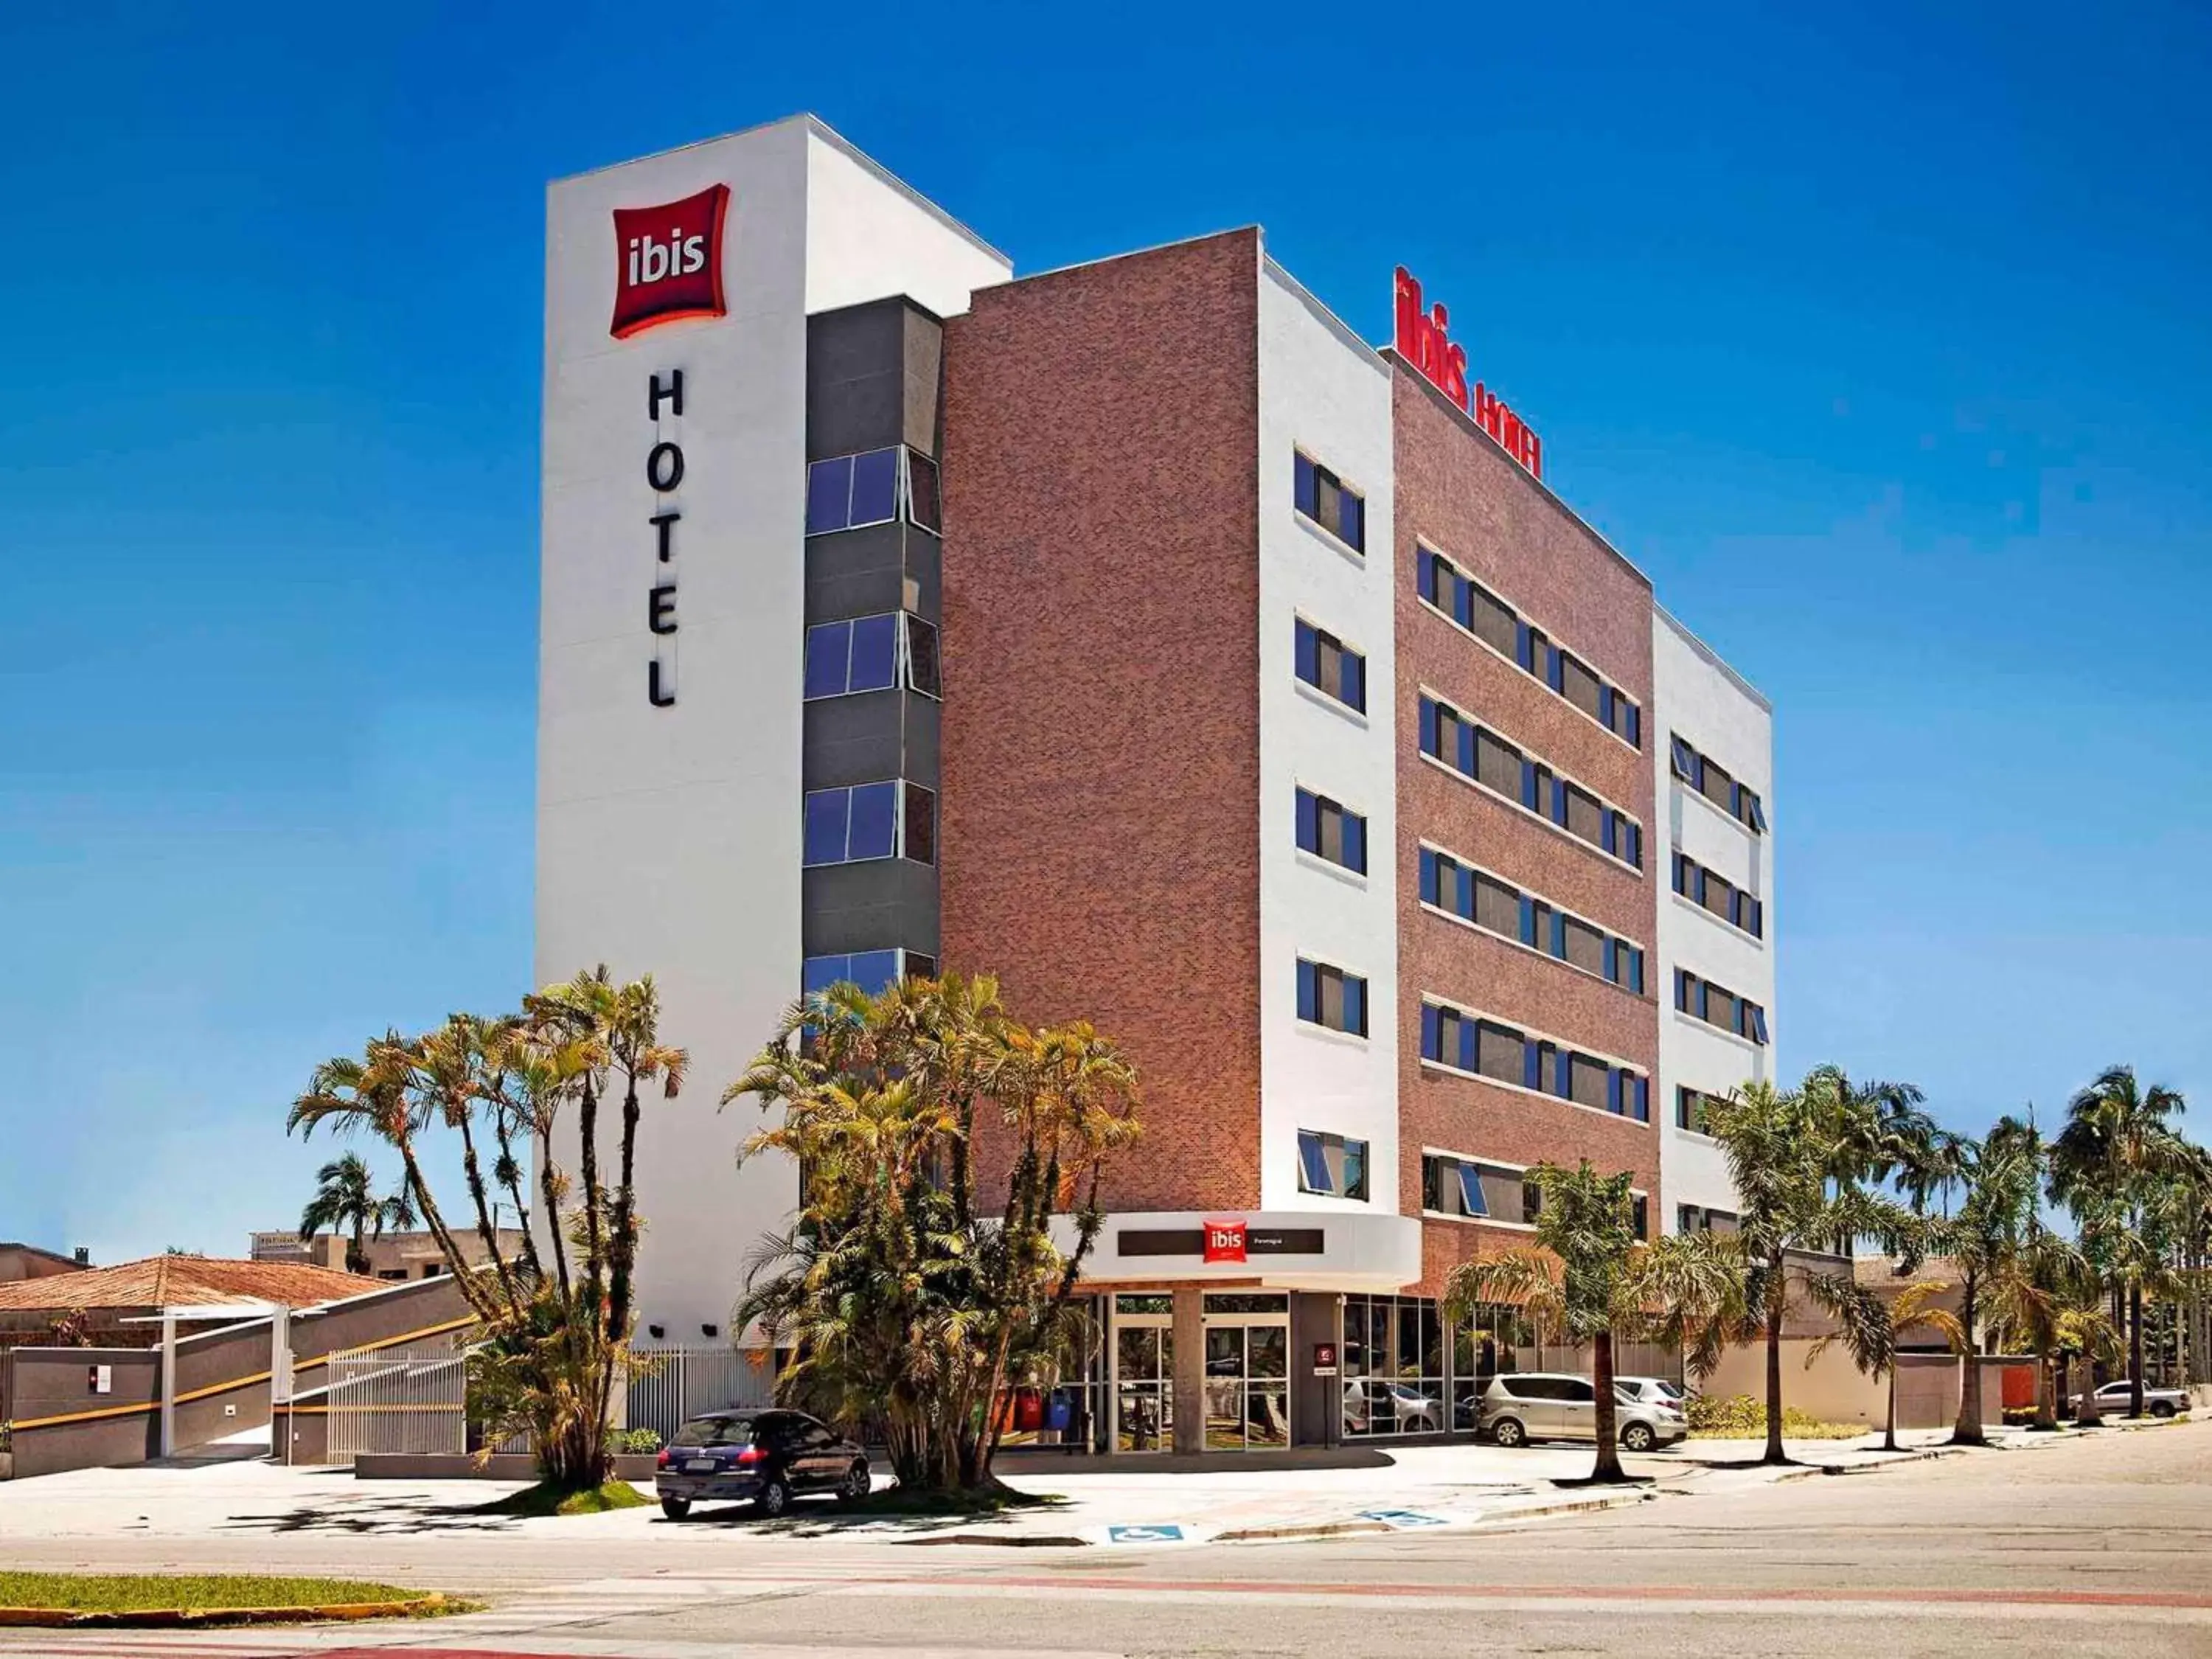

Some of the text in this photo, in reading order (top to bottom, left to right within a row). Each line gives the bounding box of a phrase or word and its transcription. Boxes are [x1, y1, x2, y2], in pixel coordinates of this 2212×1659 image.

[628, 227, 705, 286] ibis
[647, 369, 685, 707] HOTEL
[1211, 1231, 1242, 1248] ibis
